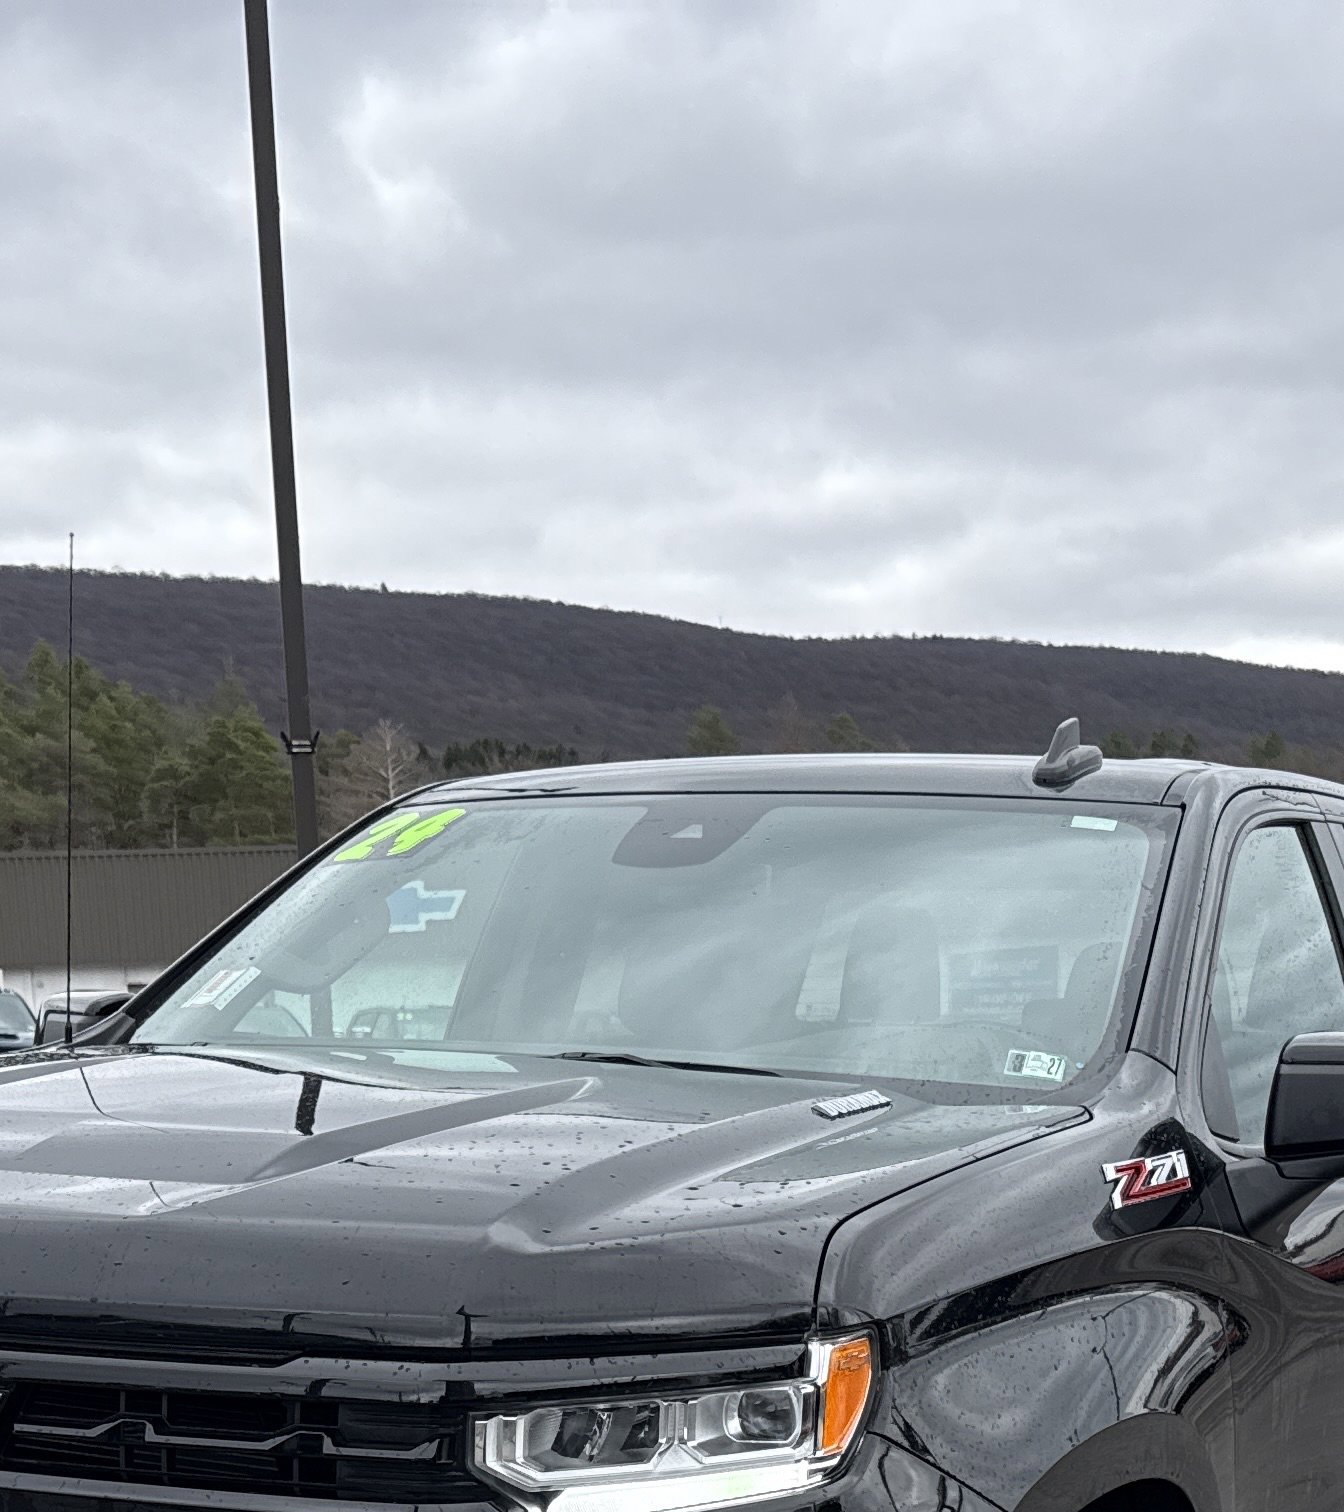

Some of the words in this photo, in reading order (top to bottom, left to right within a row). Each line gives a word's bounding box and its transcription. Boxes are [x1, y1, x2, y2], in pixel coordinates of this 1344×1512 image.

[333, 808, 467, 862] 24
[1047, 1057, 1063, 1076] 27
[1101, 1149, 1191, 1210] Z71
